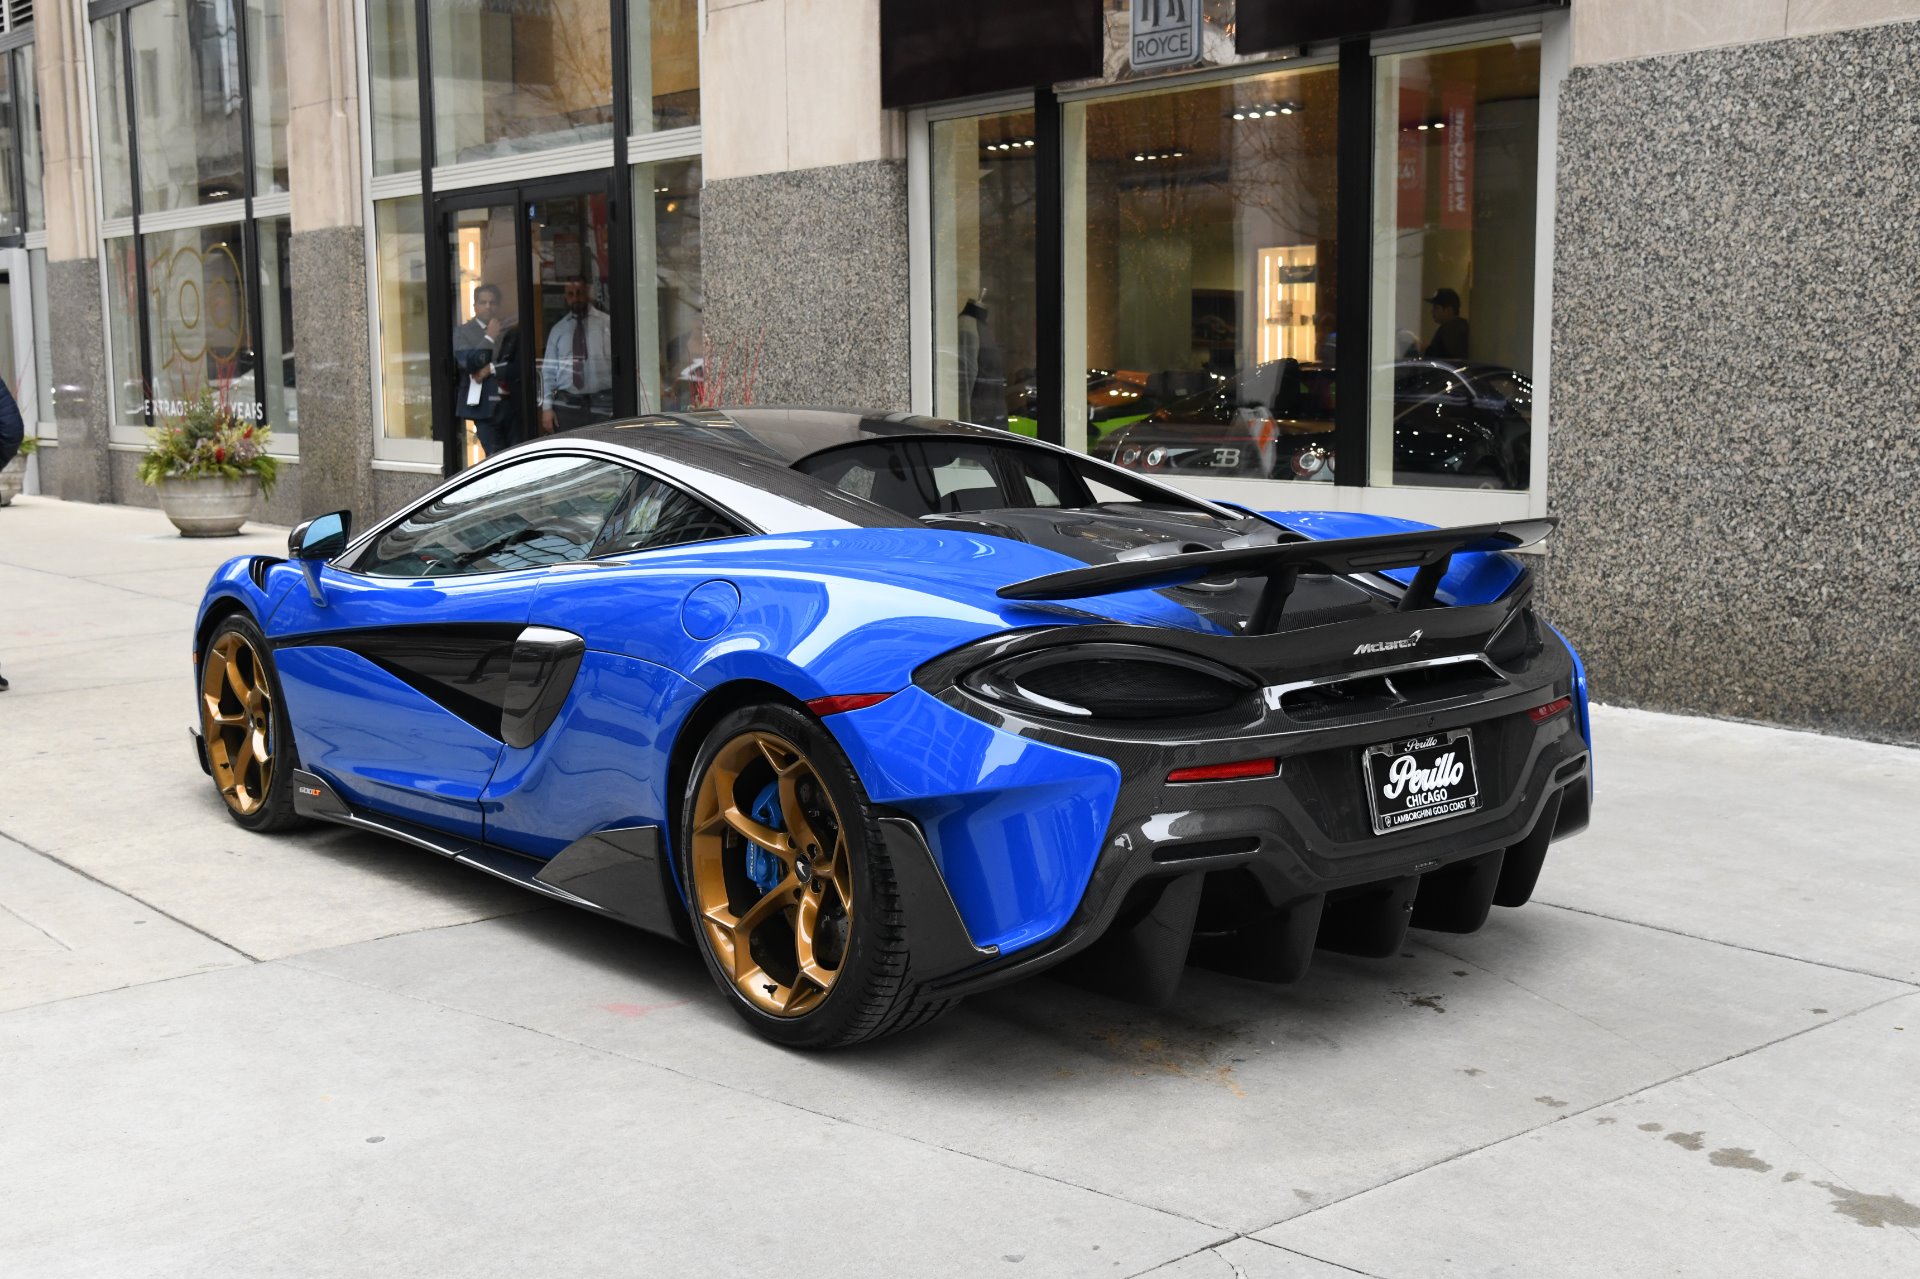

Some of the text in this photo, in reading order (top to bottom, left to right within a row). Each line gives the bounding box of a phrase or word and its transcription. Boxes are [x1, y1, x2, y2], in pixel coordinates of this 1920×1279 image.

[1136, 33, 1189, 58] ROYCE
[1353, 638, 1417, 655] McLaren
[1404, 736, 1438, 752] Perillo
[1383, 751, 1464, 800] Perillo
[1406, 788, 1448, 808] CHICAGO
[1393, 800, 1467, 824] LAMBORGHINI GOLD COAST
